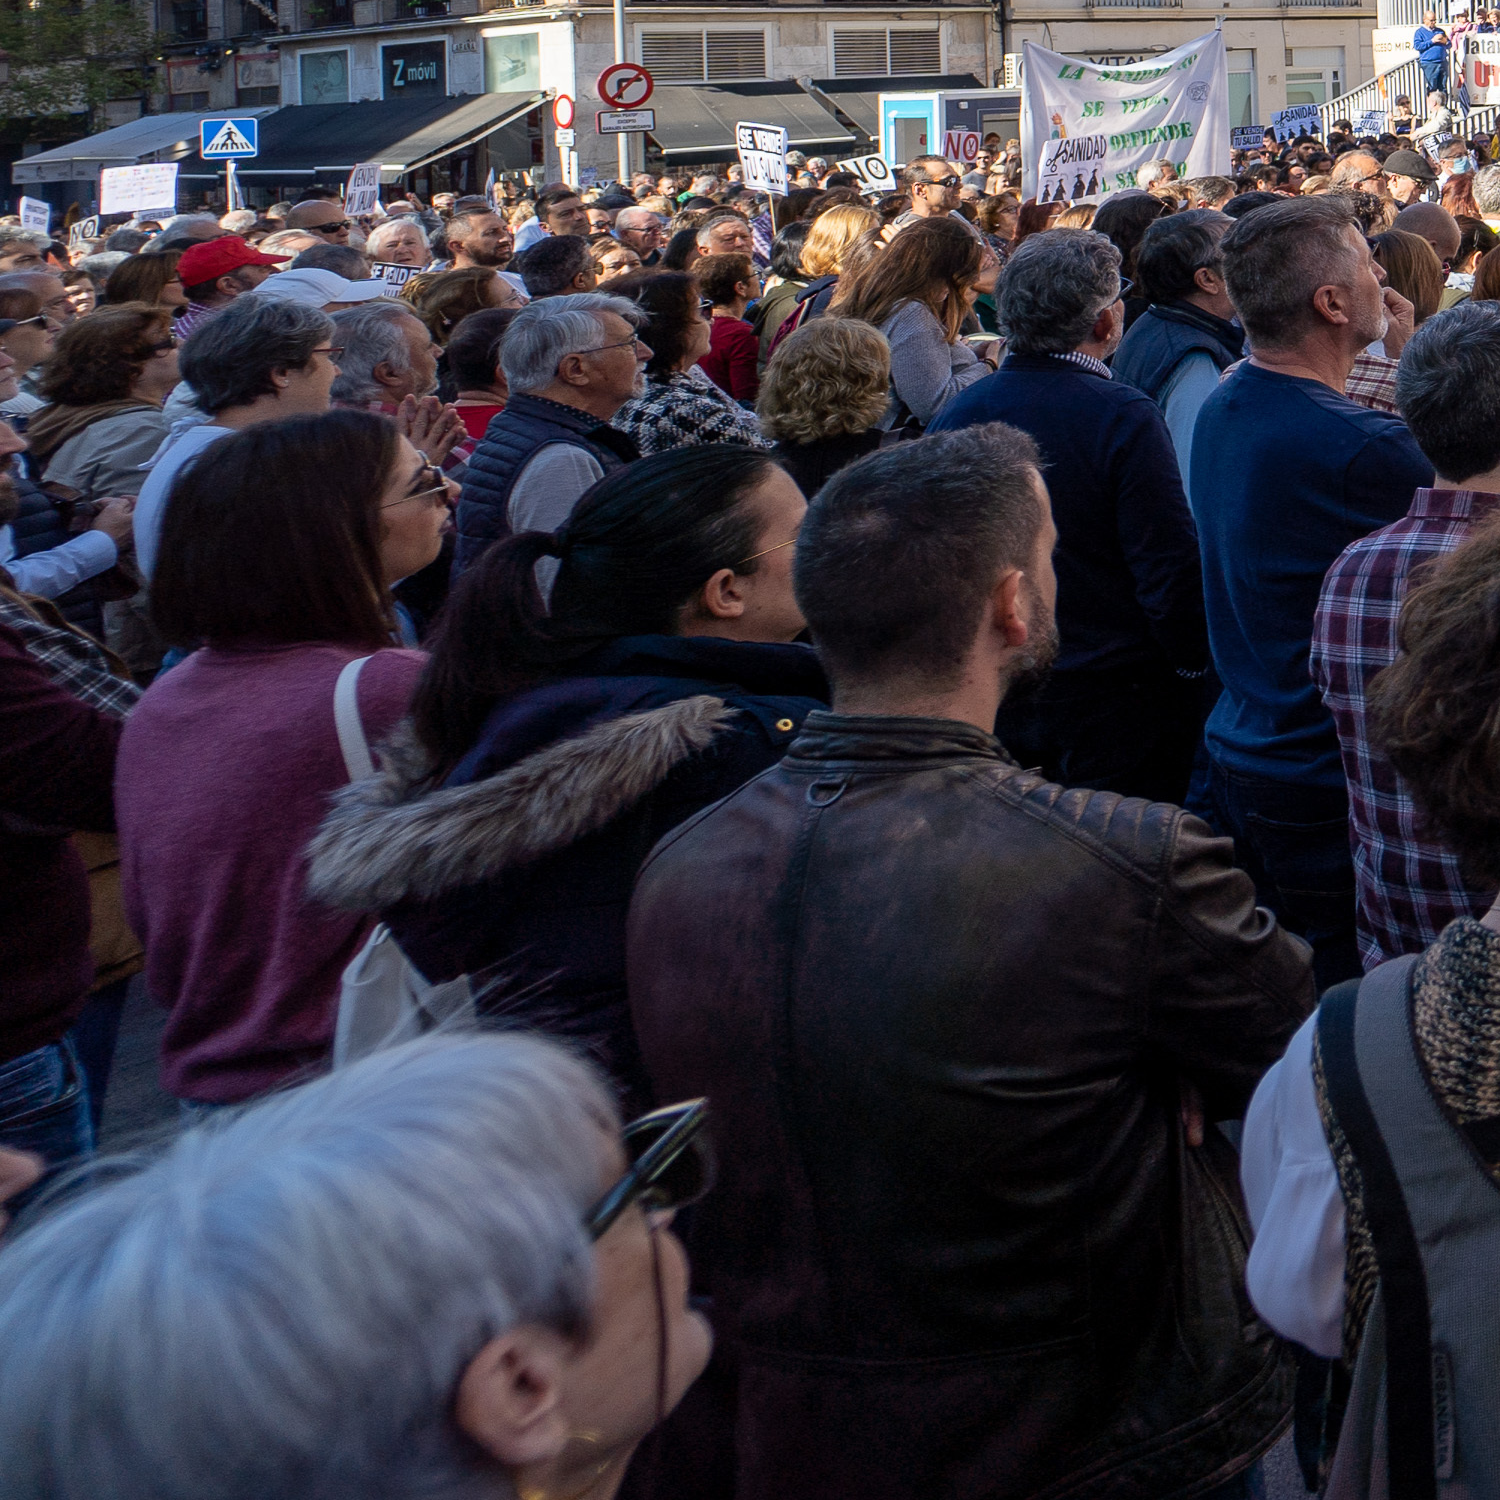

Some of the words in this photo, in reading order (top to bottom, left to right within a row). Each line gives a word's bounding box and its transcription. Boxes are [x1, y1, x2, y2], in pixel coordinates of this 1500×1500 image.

[392, 59, 405, 87] Z
[407, 61, 437, 82] móvil
[1057, 64, 1087, 80] LA
[1081, 101, 1105, 118] SE
[1286, 104, 1318, 123] SANIDAD
[738, 127, 754, 150] SE
[753, 128, 782, 156] VENDE
[1109, 121, 1194, 151] DEFIENDE
[1243, 126, 1264, 136] VENDE
[944, 131, 980, 163] NO
[1061, 134, 1107, 166] SANIDAD
[742, 154, 758, 182] TU
